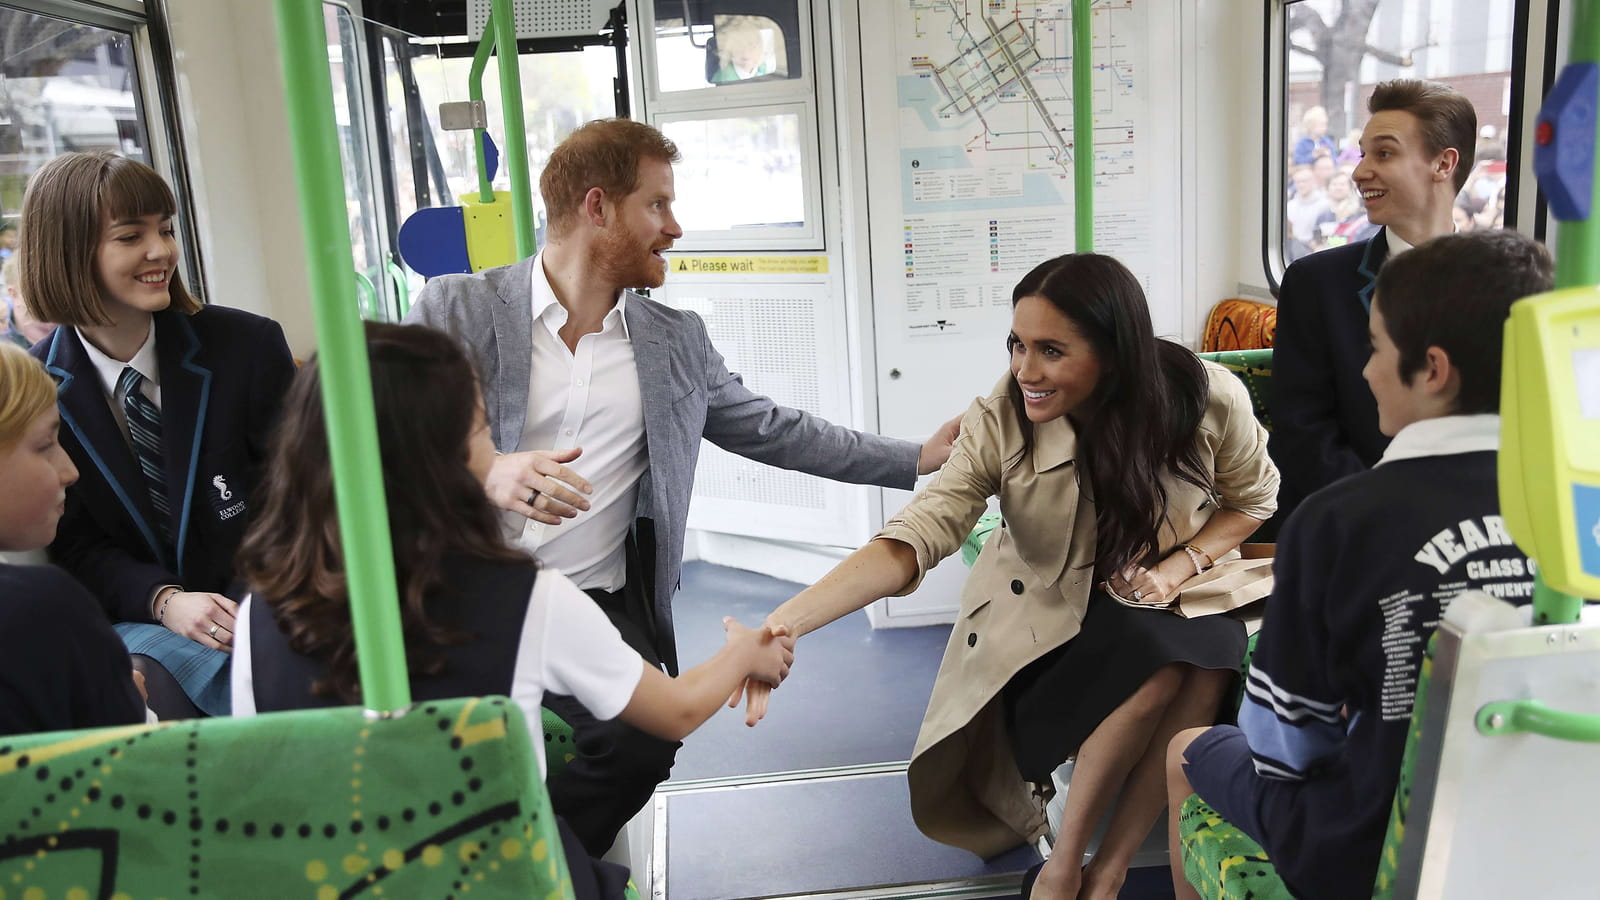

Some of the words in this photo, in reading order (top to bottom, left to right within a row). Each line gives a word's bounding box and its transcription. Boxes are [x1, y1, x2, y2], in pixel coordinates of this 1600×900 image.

[692, 259, 727, 272] Please
[730, 259, 754, 271] wait
[219, 501, 244, 515] ELWOOD
[1414, 515, 1513, 575] YEAR
[1466, 558, 1524, 580] CLASS
